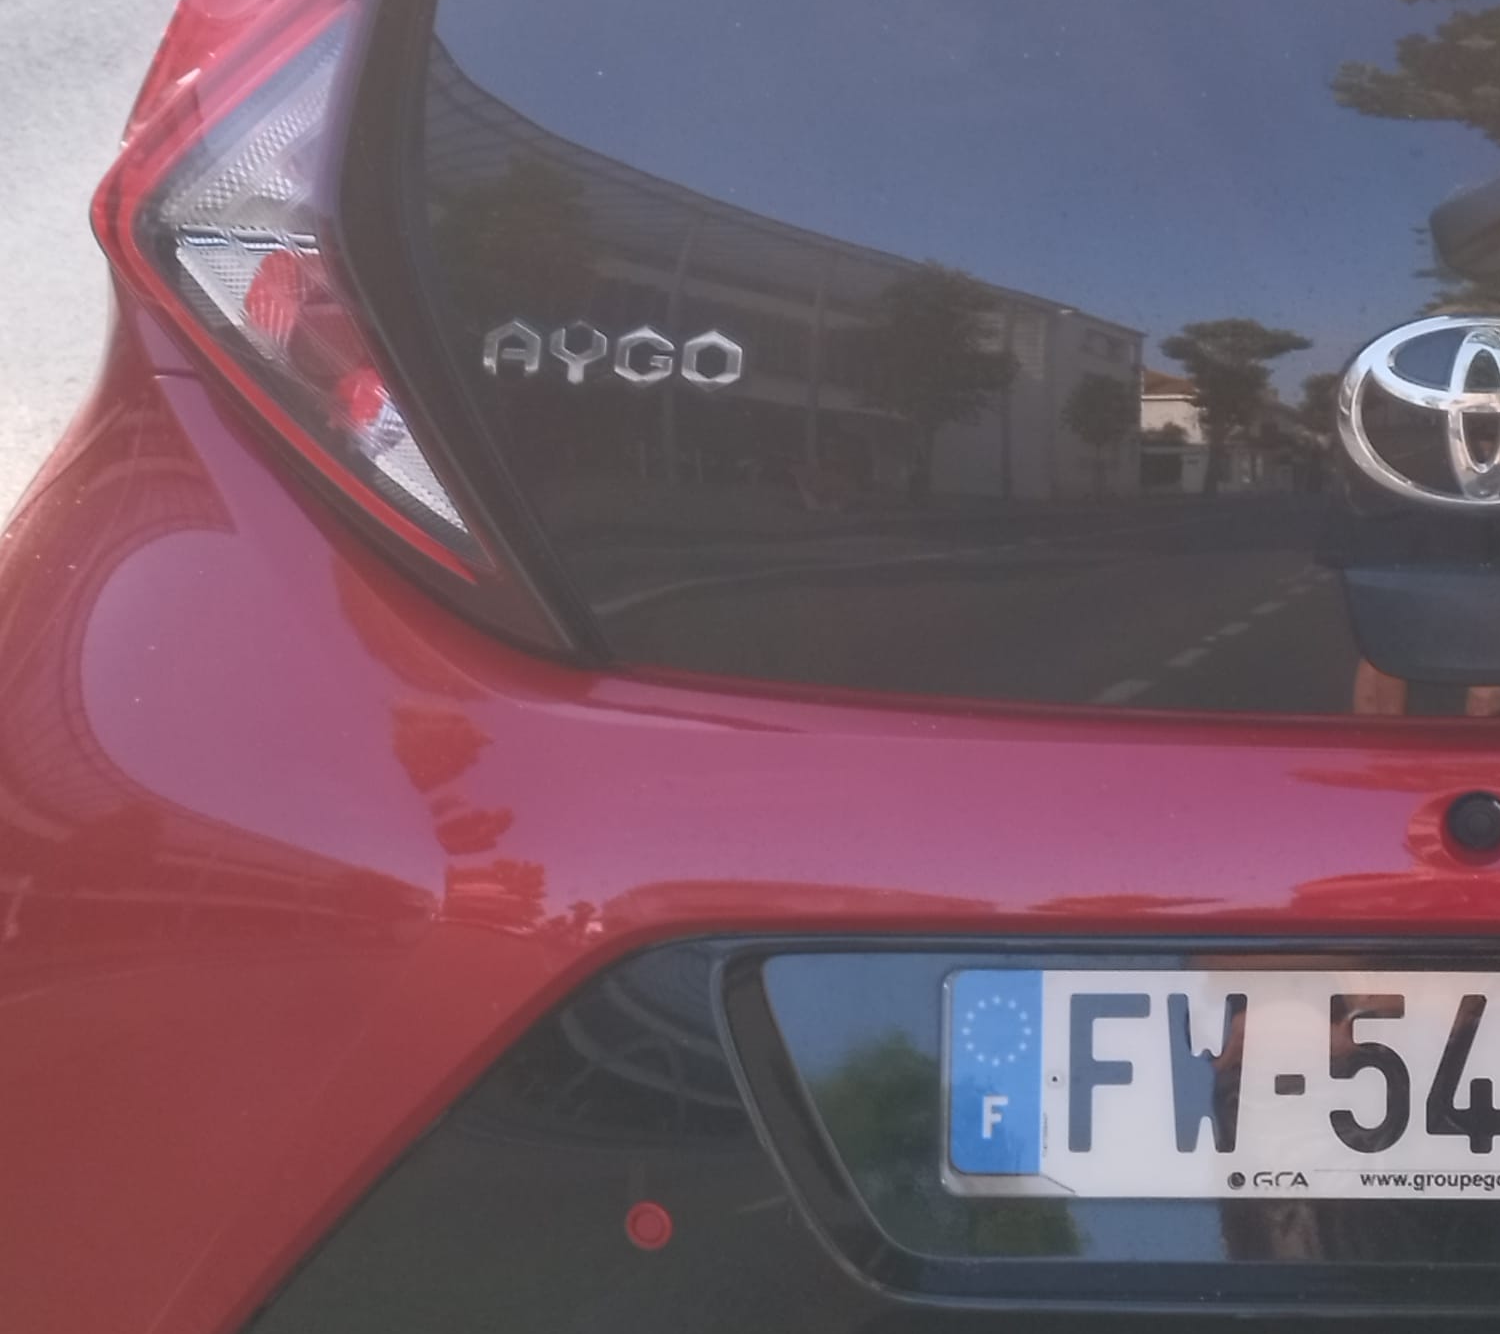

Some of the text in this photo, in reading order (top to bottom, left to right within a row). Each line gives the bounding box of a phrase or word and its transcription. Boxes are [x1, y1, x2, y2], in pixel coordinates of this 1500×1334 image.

[483, 318, 743, 390] AYGO
[982, 1095, 1009, 1140] F
[1253, 1171, 1309, 1190] GCA
